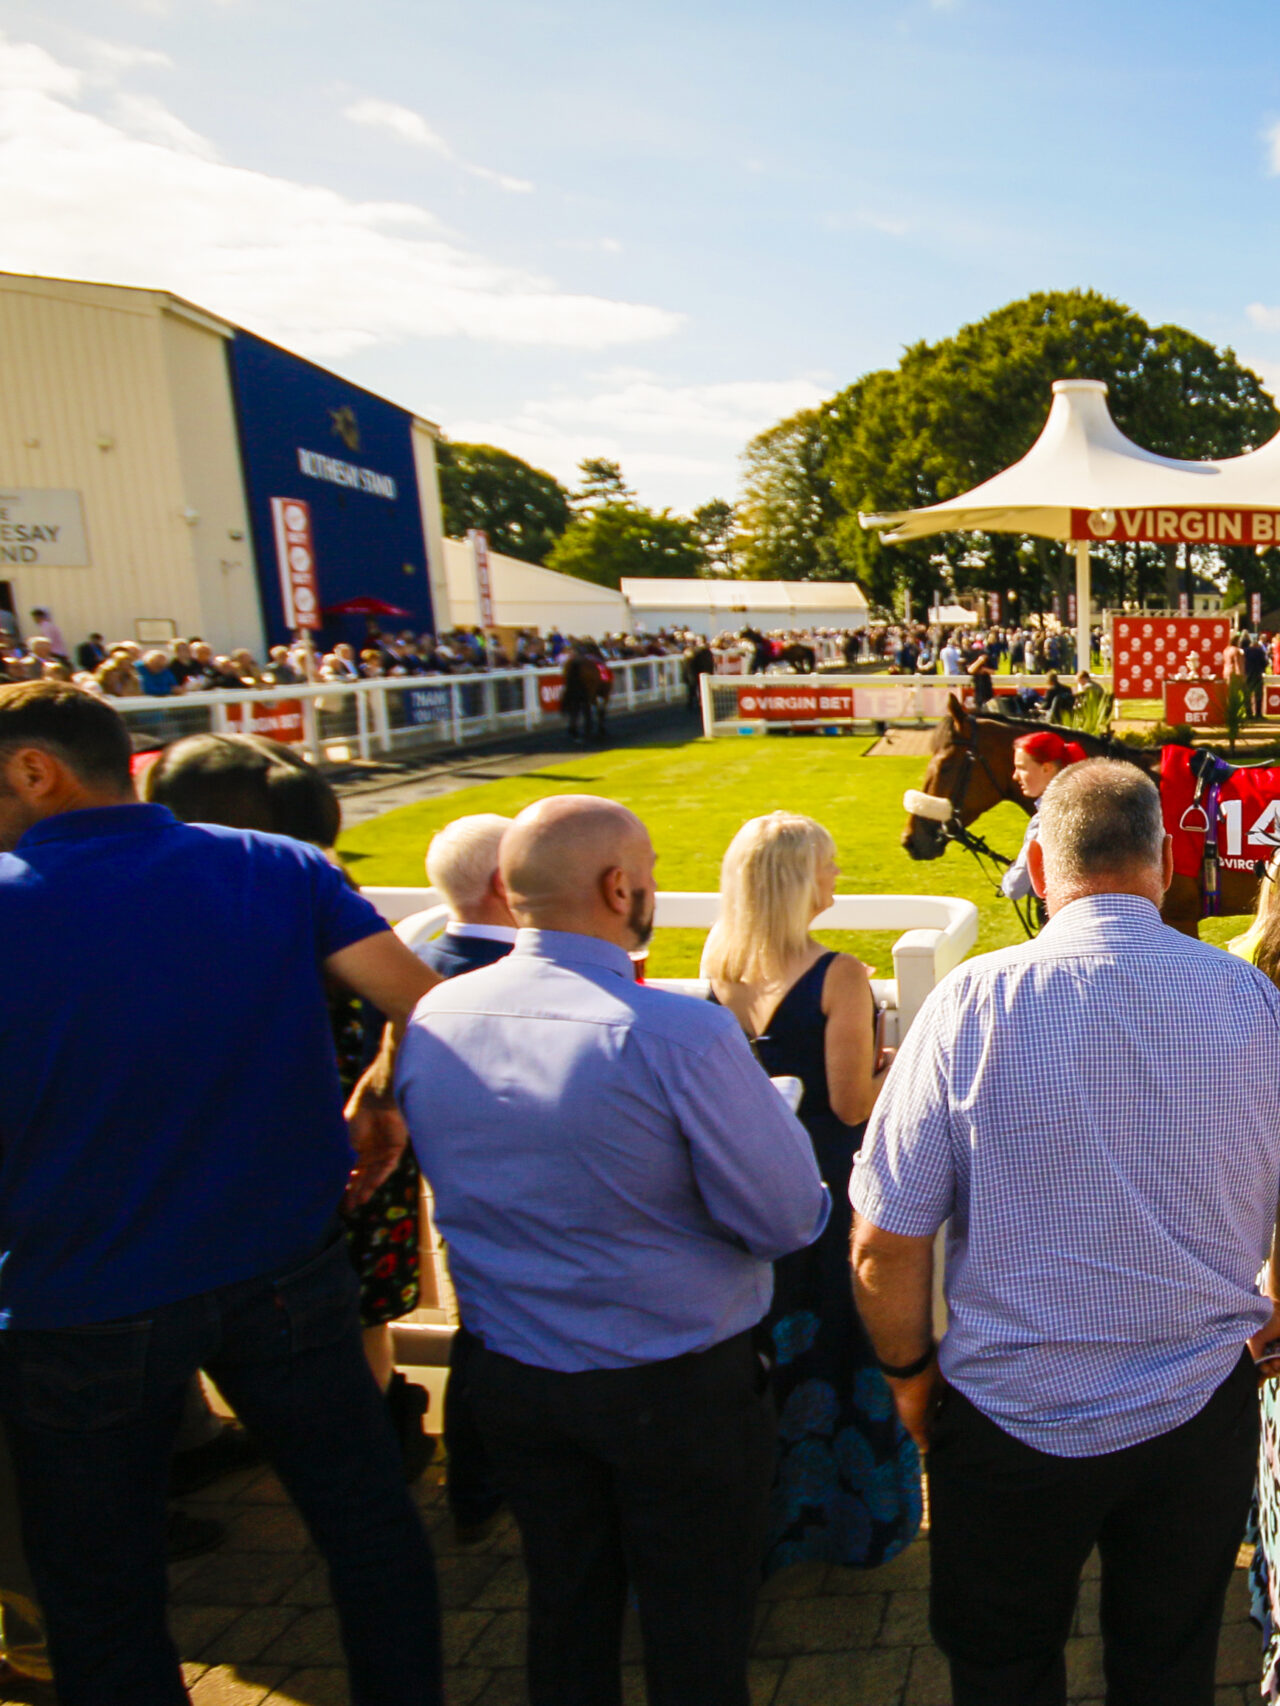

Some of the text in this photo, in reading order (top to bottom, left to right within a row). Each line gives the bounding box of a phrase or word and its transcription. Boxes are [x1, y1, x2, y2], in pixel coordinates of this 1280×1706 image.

[1120, 510, 1243, 540] VIRGIN
[756, 696, 850, 710] VIRGIN BET
[1185, 712, 1208, 723] BET
[1224, 858, 1270, 870] VIRG
